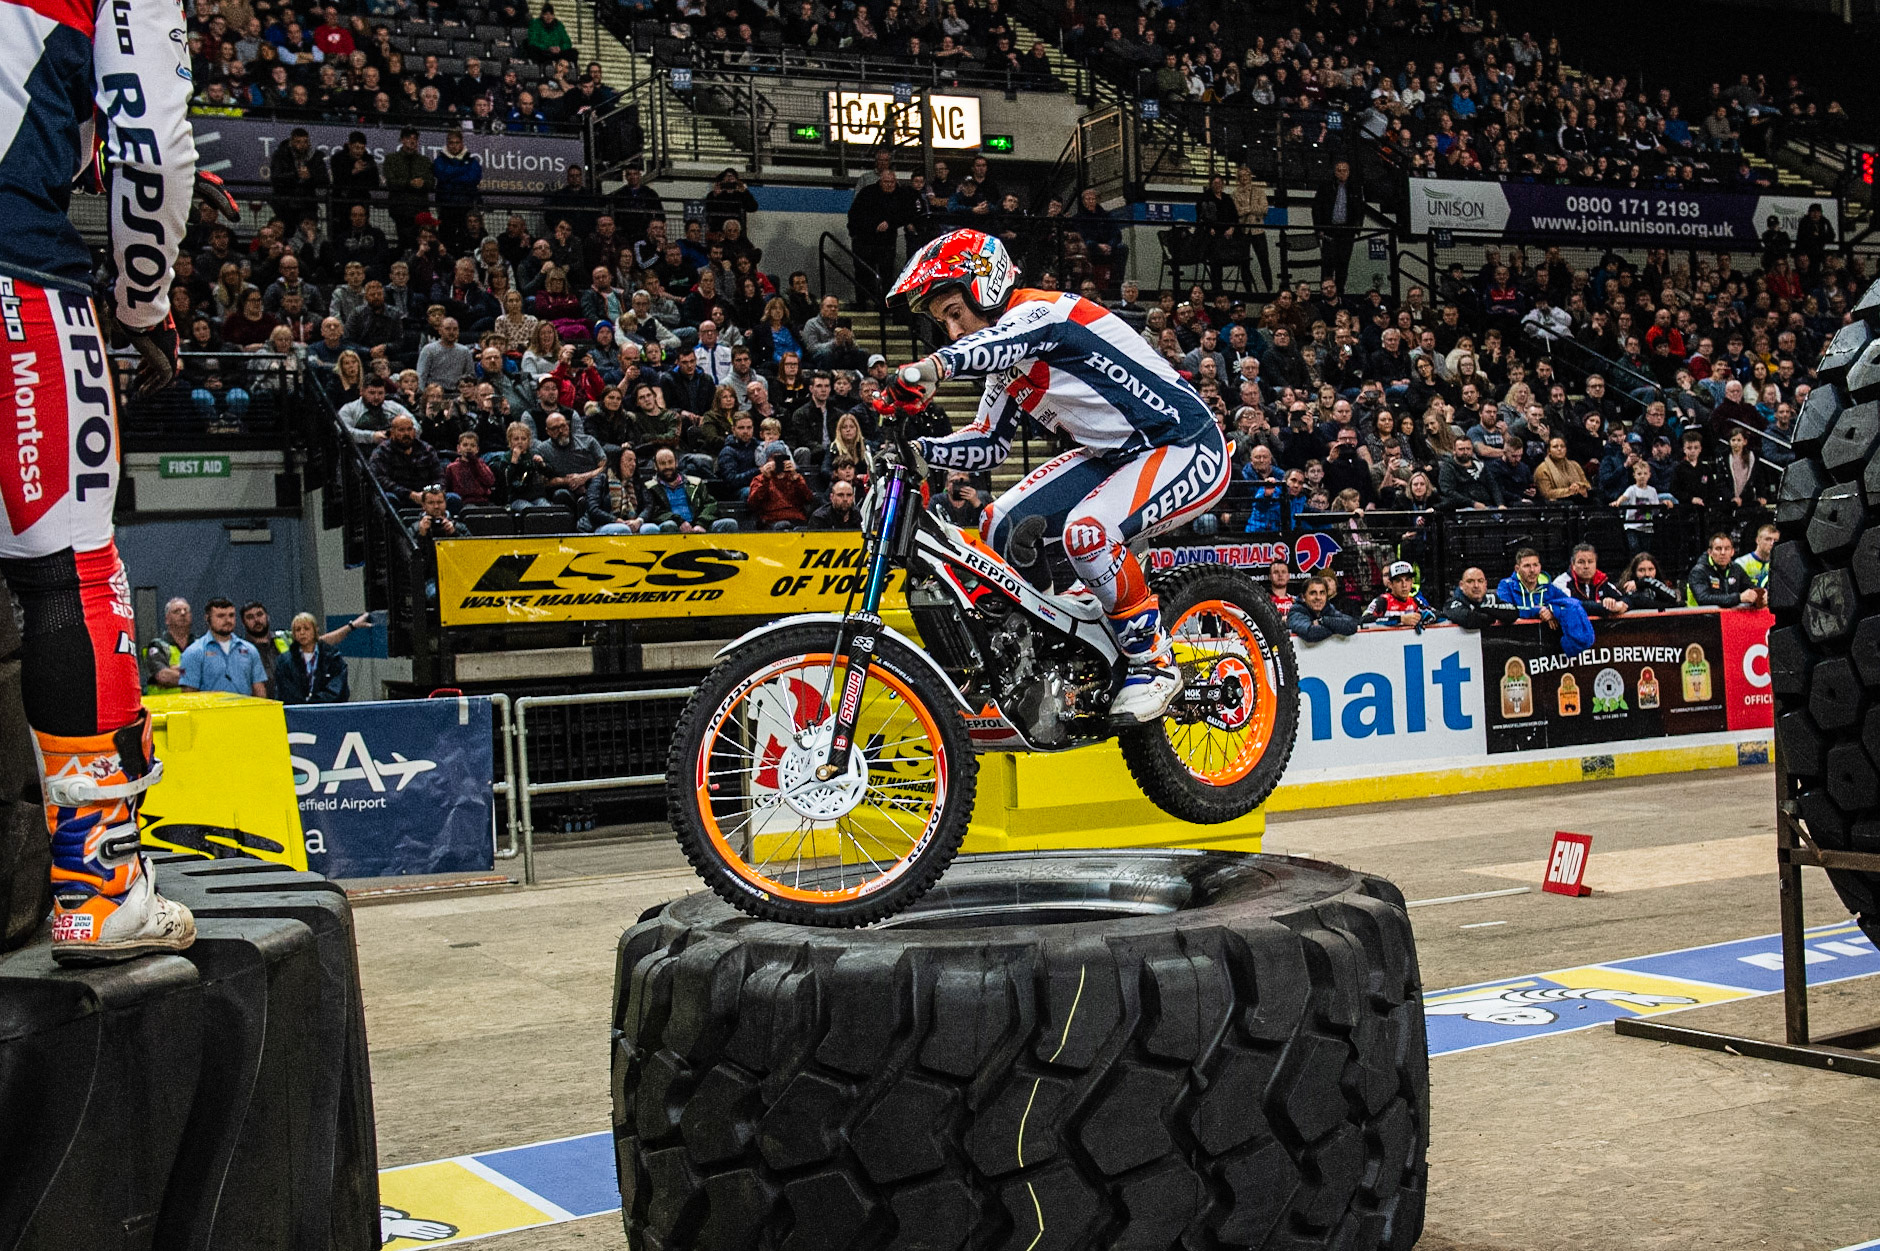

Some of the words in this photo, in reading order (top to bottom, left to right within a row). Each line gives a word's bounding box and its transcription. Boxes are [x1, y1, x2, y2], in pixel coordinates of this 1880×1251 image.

[673, 73, 691, 81] 217
[895, 87, 912, 96] 216
[469, 148, 566, 172] olutions
[687, 206, 704, 214] 117
[1427, 200, 1484, 218] UNISON
[1566, 196, 1612, 214] 0800
[1619, 199, 1649, 215] 171
[1656, 201, 1700, 218] 2193
[1531, 215, 1734, 238] www.join.unison.org.uk
[1083, 352, 1181, 424] HONDA
[11, 352, 43, 503] Montesa
[168, 461, 198, 473] FIRST
[203, 461, 222, 473] AID
[1018, 449, 1082, 493] HONDA
[1141, 444, 1221, 530] REPSOL
[470, 549, 749, 593] LSS
[799, 549, 869, 568] TAK
[769, 576, 813, 597] OF
[964, 554, 1022, 597] REPSOL
[459, 596, 533, 609] WASTE
[534, 590, 681, 608] MANAGEMENT
[685, 588, 724, 601] LTD
[1242, 611, 1271, 661] REPSOL
[882, 659, 915, 685] MICHELIN
[1529, 648, 1611, 675] BRADFIELD
[1613, 646, 1682, 664] BREWERY
[707, 679, 752, 733] REPSOL
[840, 672, 862, 725] SHOWA
[1185, 689, 1200, 699] NGK
[340, 797, 387, 812] Airport
[908, 804, 943, 863] REPSOL
[1548, 840, 1585, 885] END
